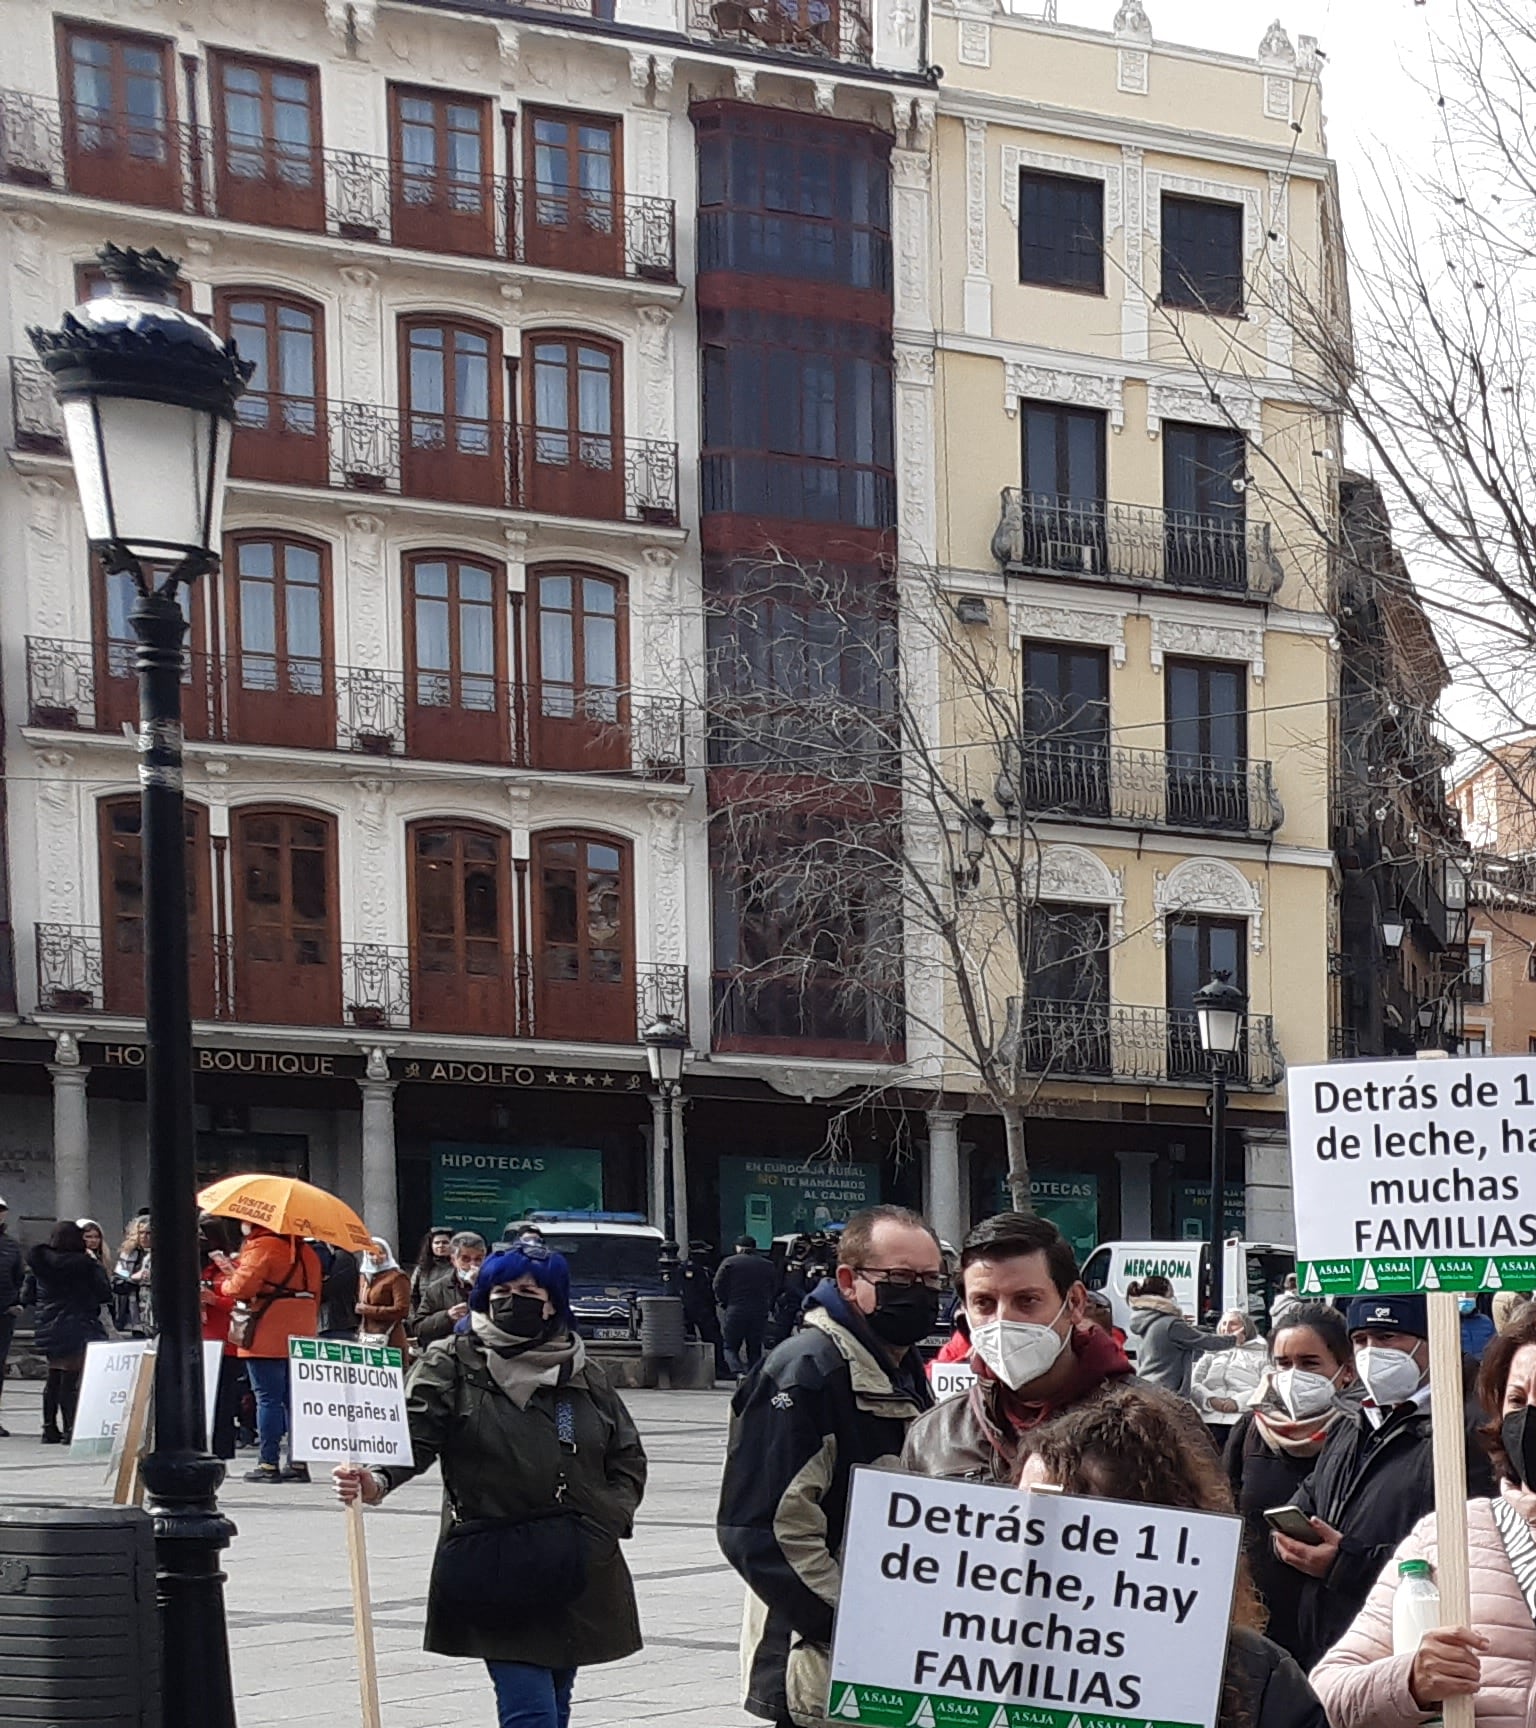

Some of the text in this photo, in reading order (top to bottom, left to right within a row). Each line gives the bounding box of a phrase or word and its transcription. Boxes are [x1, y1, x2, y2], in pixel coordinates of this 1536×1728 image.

[200, 1050, 334, 1075] BOUTIQUE
[431, 1062, 535, 1085] ADOLFO
[1314, 1075, 1437, 1113] Detrás
[1450, 1073, 1498, 1107] de
[1514, 1074, 1534, 1106] 1
[1317, 1126, 1360, 1160] de
[1374, 1121, 1487, 1161] leche,
[441, 1154, 545, 1171] HIPOTECAS
[757, 1174, 865, 1190] NO TE MANDAMOS
[1001, 1181, 1092, 1196] HOTECAS
[1371, 1168, 1519, 1204] muchas
[238, 1195, 276, 1212] VISITAS
[804, 1191, 865, 1201] AL CAJERO
[228, 1204, 272, 1222] GUIADAS
[1124, 1259, 1192, 1278] MERCADONA
[298, 1363, 398, 1389] DISTRIBUCIÓN
[303, 1401, 400, 1422] no engañes al
[312, 1435, 398, 1454] consumidor
[887, 1492, 1201, 1566] Detrás de 1 l.
[881, 1544, 1198, 1624] de leche, hay
[942, 1610, 1126, 1658] muchas
[914, 1650, 1142, 1710] FAMILIAS
[860, 1691, 903, 1706] ASAJA
[936, 1702, 979, 1716] ASAJA
